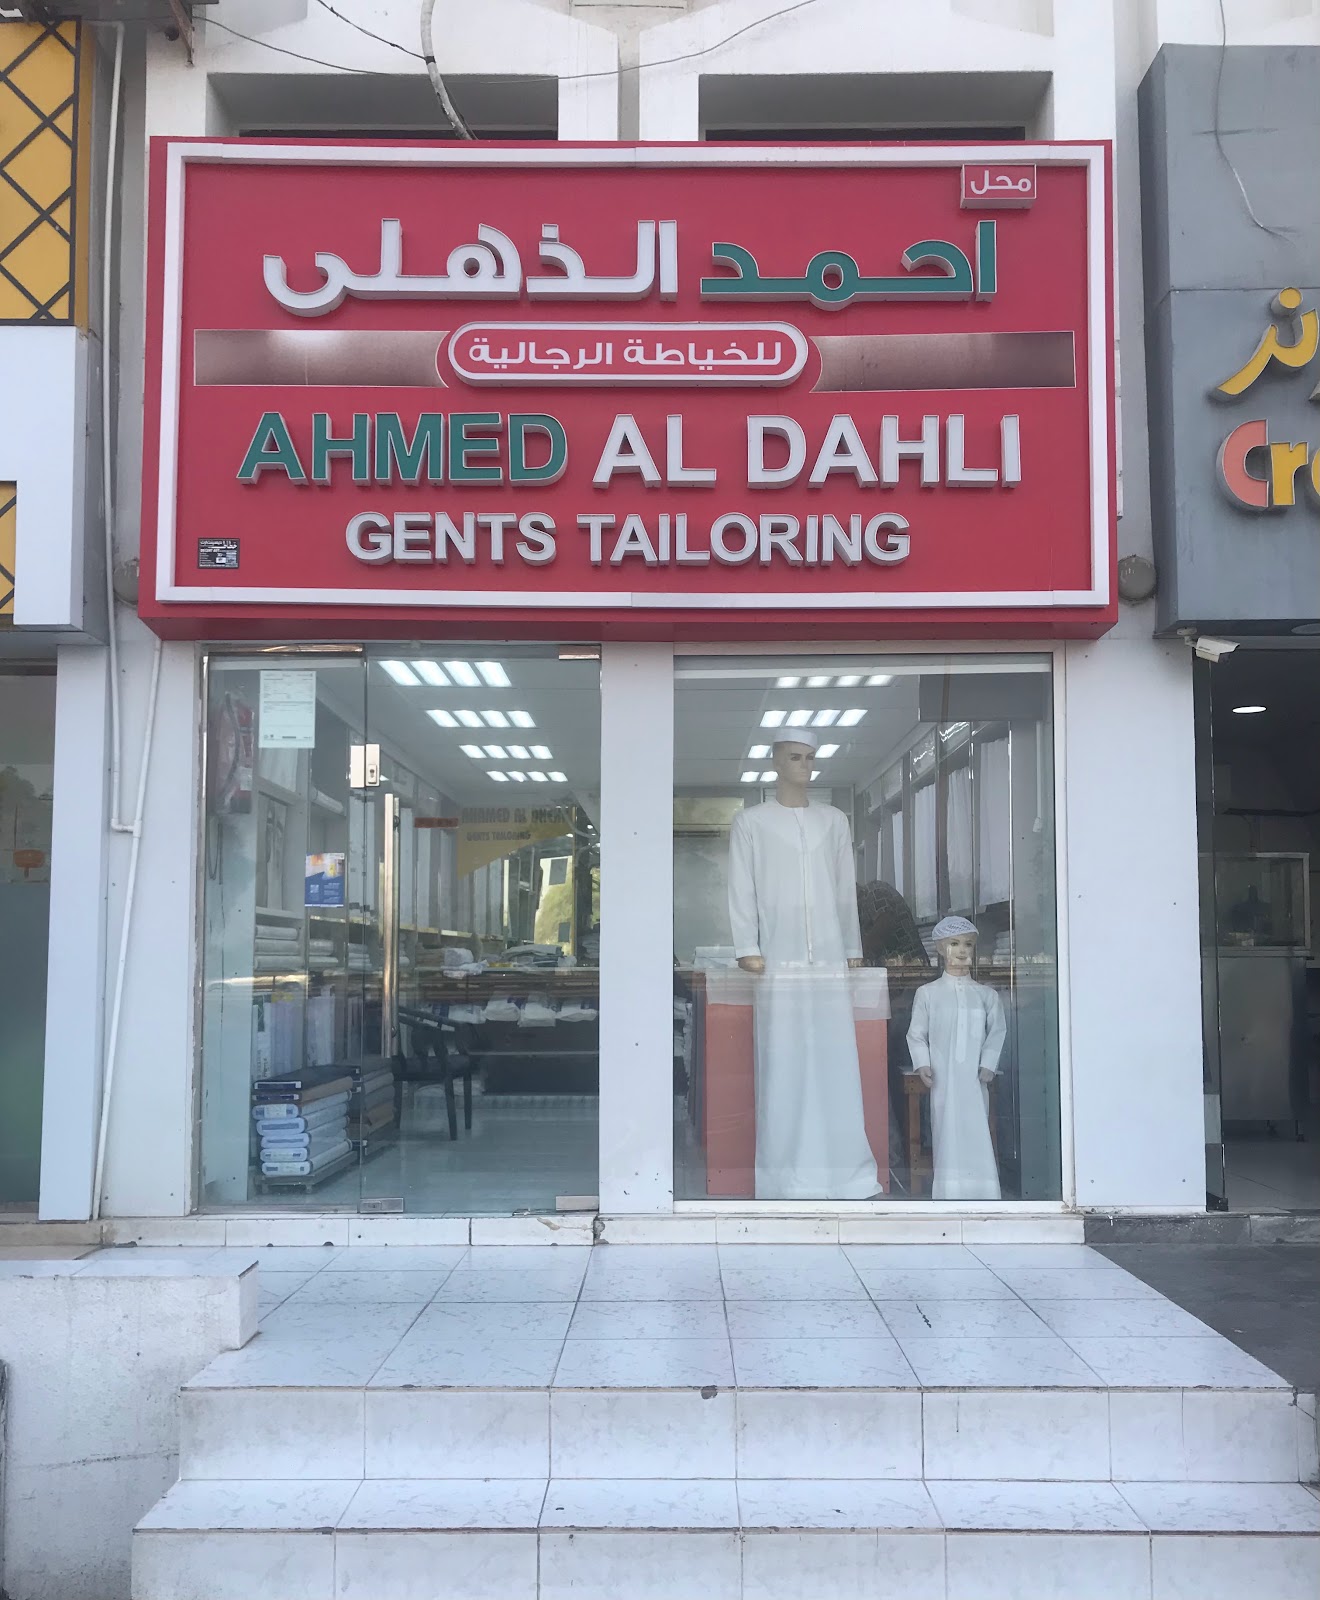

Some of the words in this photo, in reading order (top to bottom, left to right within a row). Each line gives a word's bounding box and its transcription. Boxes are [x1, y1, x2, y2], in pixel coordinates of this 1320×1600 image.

[970, 169, 1032, 195] محل
[700, 219, 998, 306] احمد
[467, 336, 613, 370] الرجالية
[622, 338, 782, 371] للخياطة
[236, 411, 569, 487] AHMED
[592, 413, 718, 489] AL
[746, 413, 1022, 489] DAHLI
[1218, 418, 1320, 510] Cr
[345, 510, 557, 566] GENTS
[576, 511, 912, 567] TAILORING
